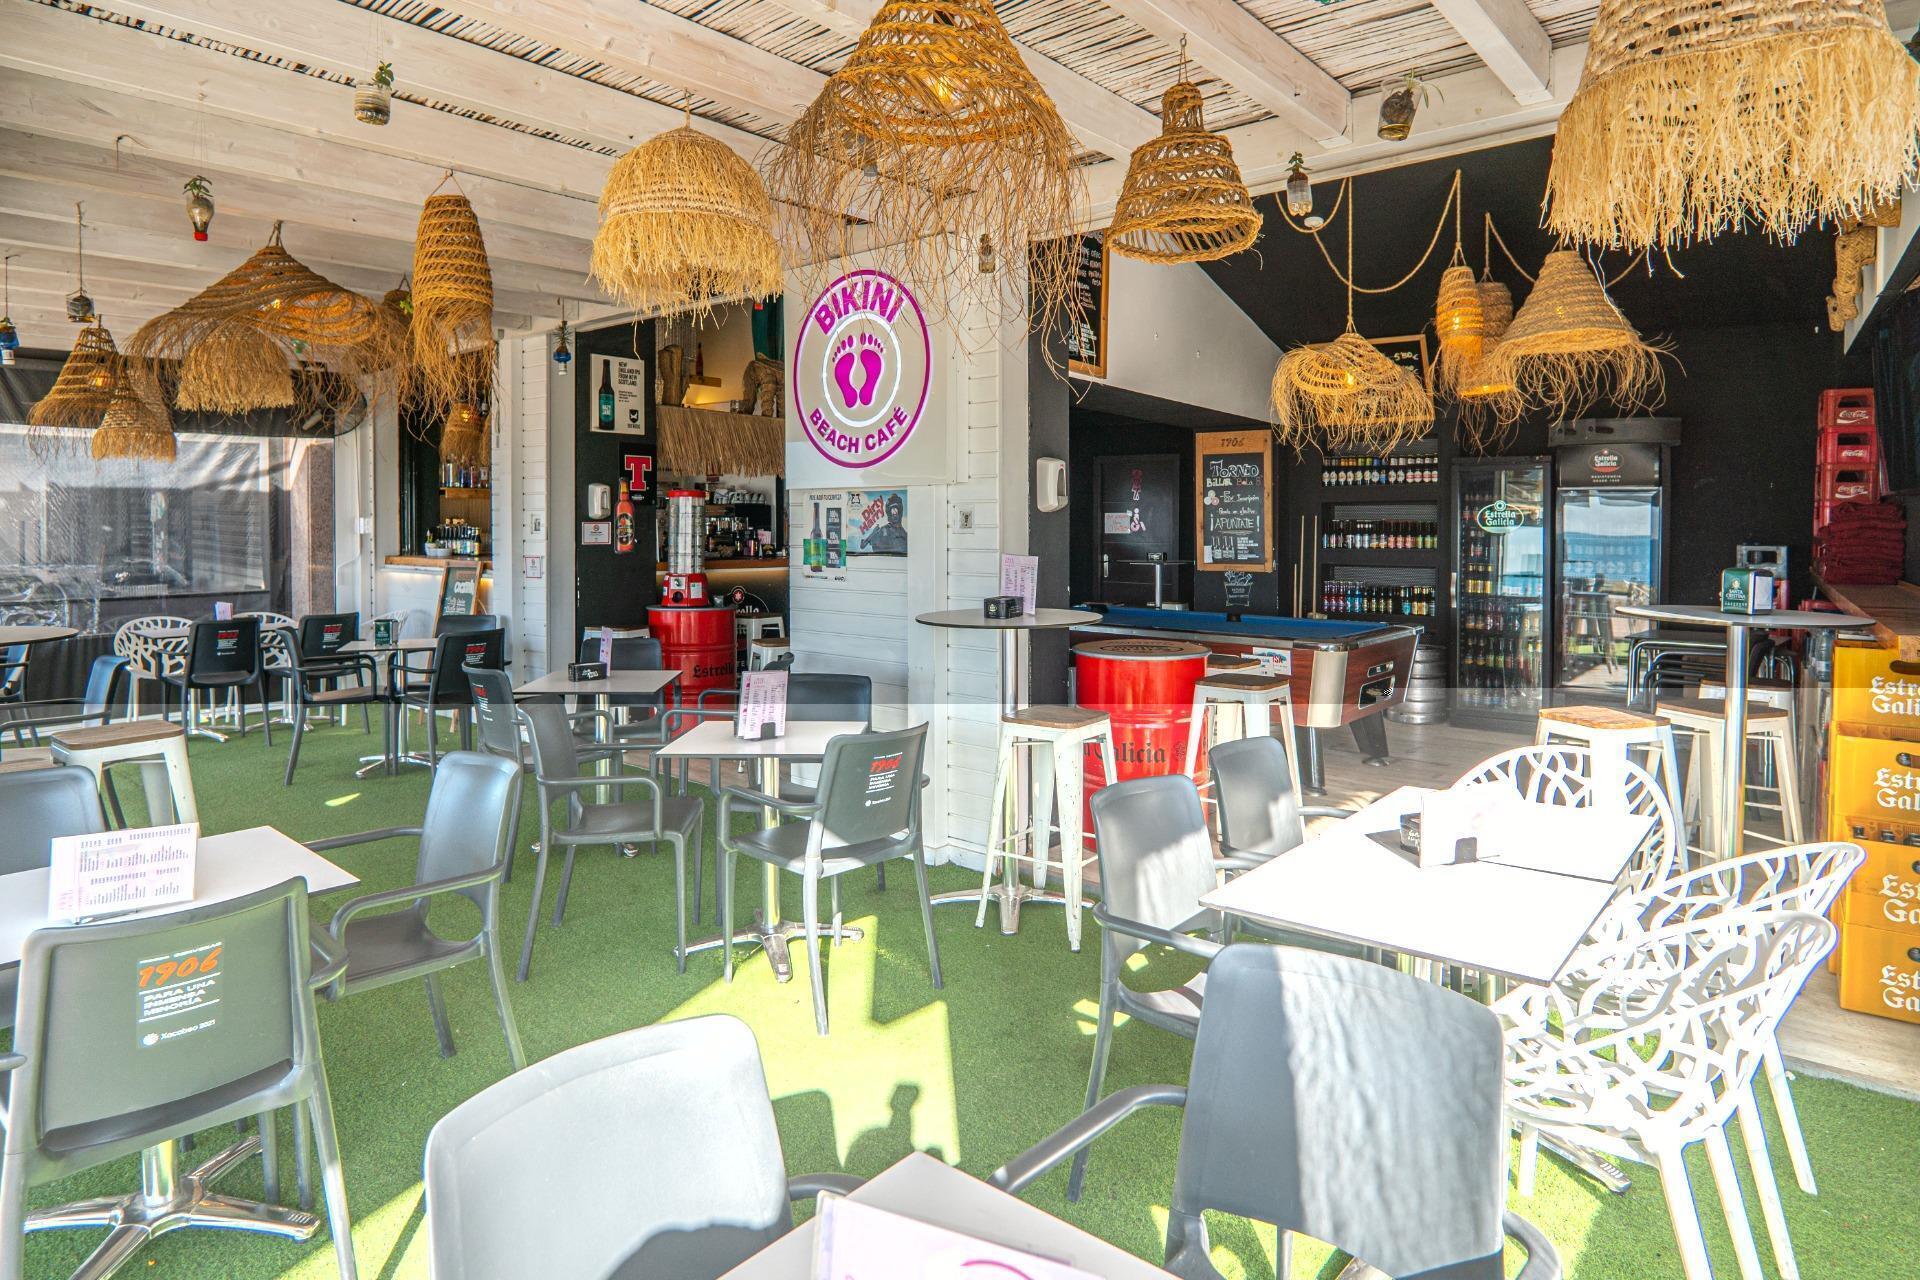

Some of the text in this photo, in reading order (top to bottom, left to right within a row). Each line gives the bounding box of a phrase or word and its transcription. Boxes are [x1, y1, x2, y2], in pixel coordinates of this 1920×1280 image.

[815, 280, 904, 335] BIKINI
[810, 407, 908, 453] BEACH CAFÉ
[624, 454, 652, 491] T
[1485, 510, 1516, 519] Estrella
[1485, 518, 1515, 526] Galicia
[138, 947, 223, 989] 1906
